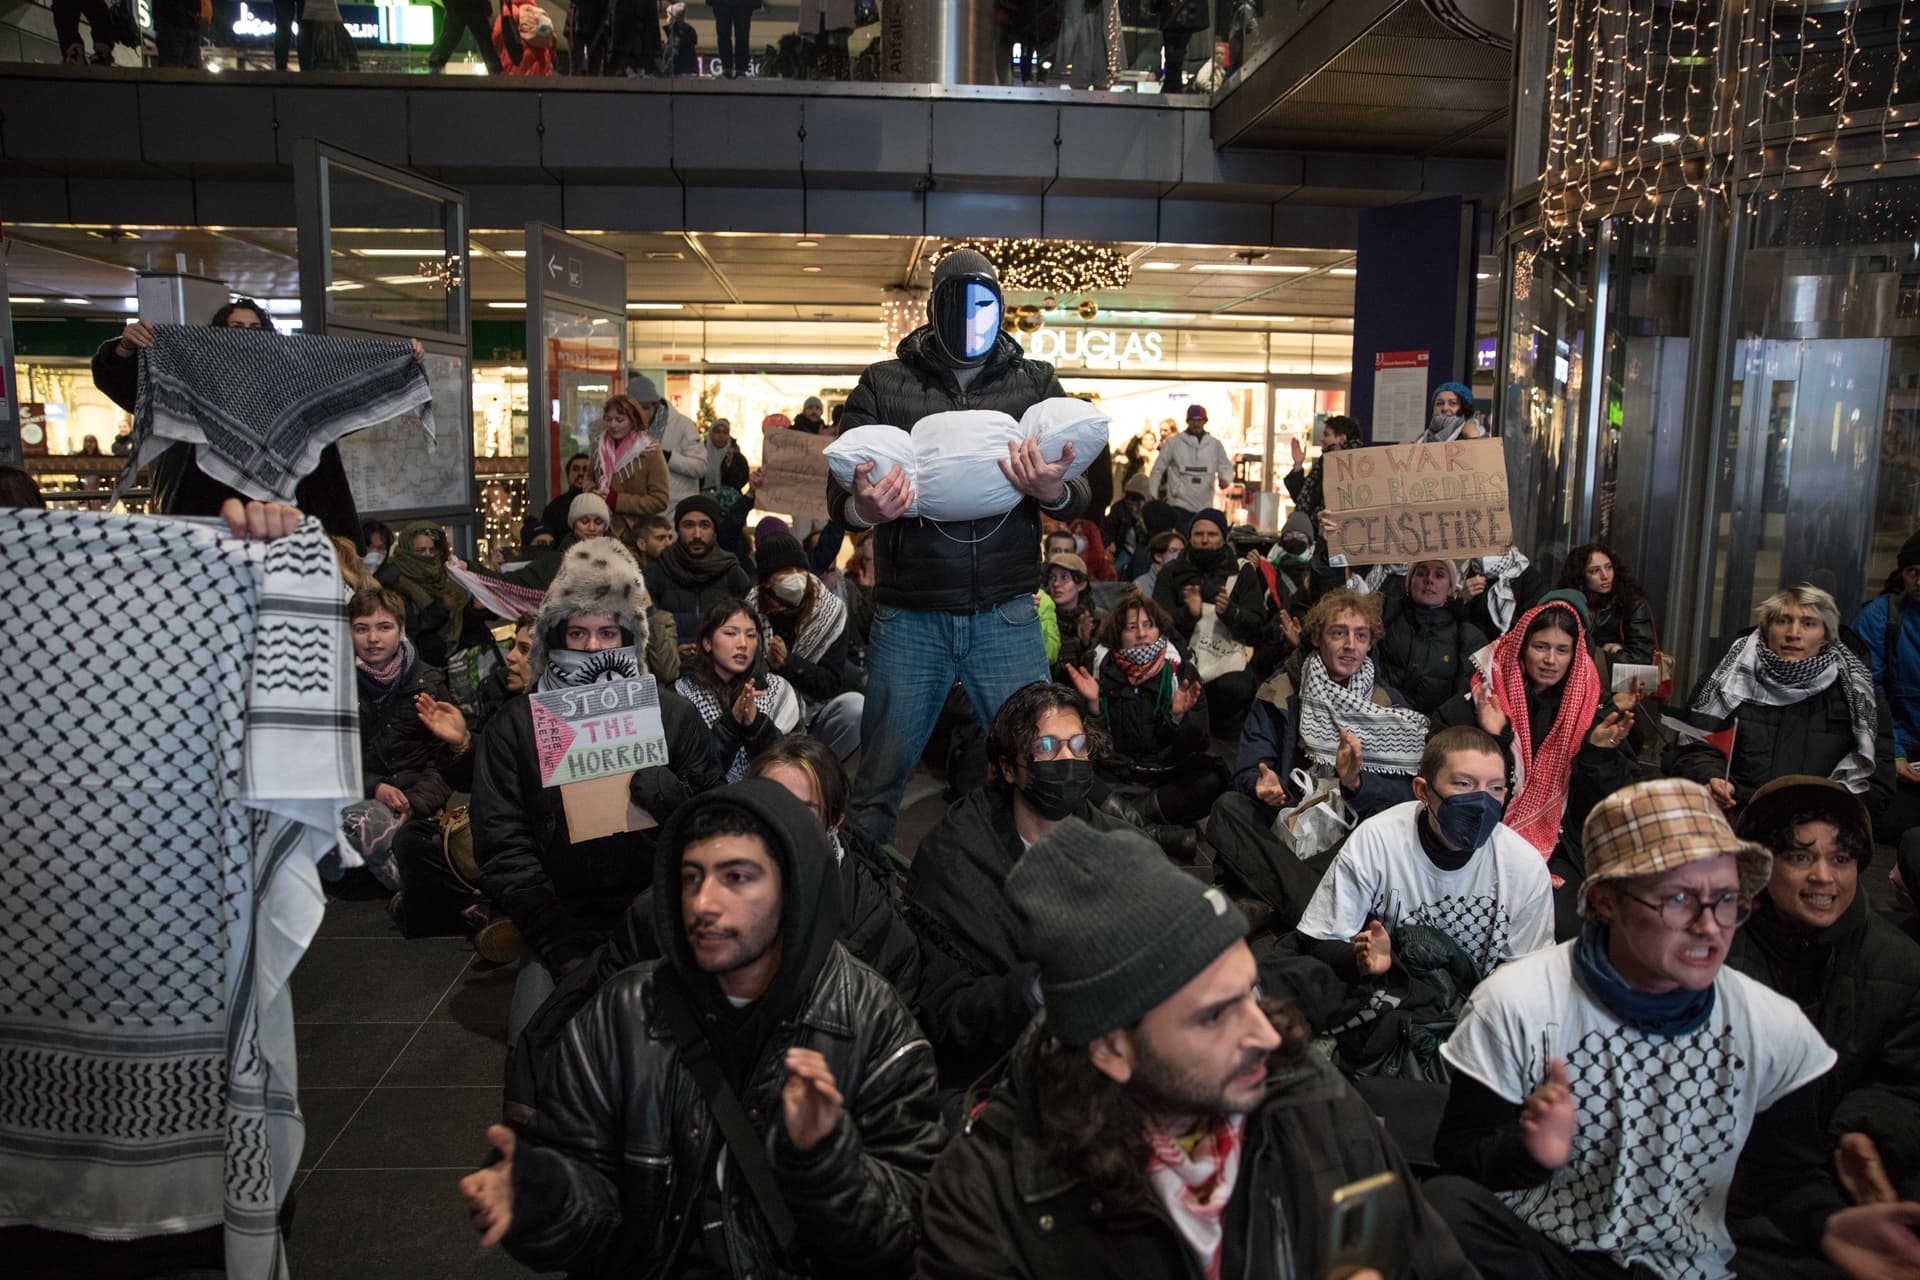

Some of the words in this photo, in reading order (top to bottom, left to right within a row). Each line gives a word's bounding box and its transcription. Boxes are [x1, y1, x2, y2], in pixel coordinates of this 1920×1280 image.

[1335, 453, 1376, 481] NO
[1385, 443, 1473, 473] WAR
[1336, 483, 1373, 510] NO
[1388, 472, 1507, 504] BORDERS
[561, 681, 643, 717] STOP
[535, 708, 555, 769] PALESTINE
[548, 718, 562, 751] FREE
[581, 714, 637, 743] THE
[567, 738, 666, 779] HORROR!
